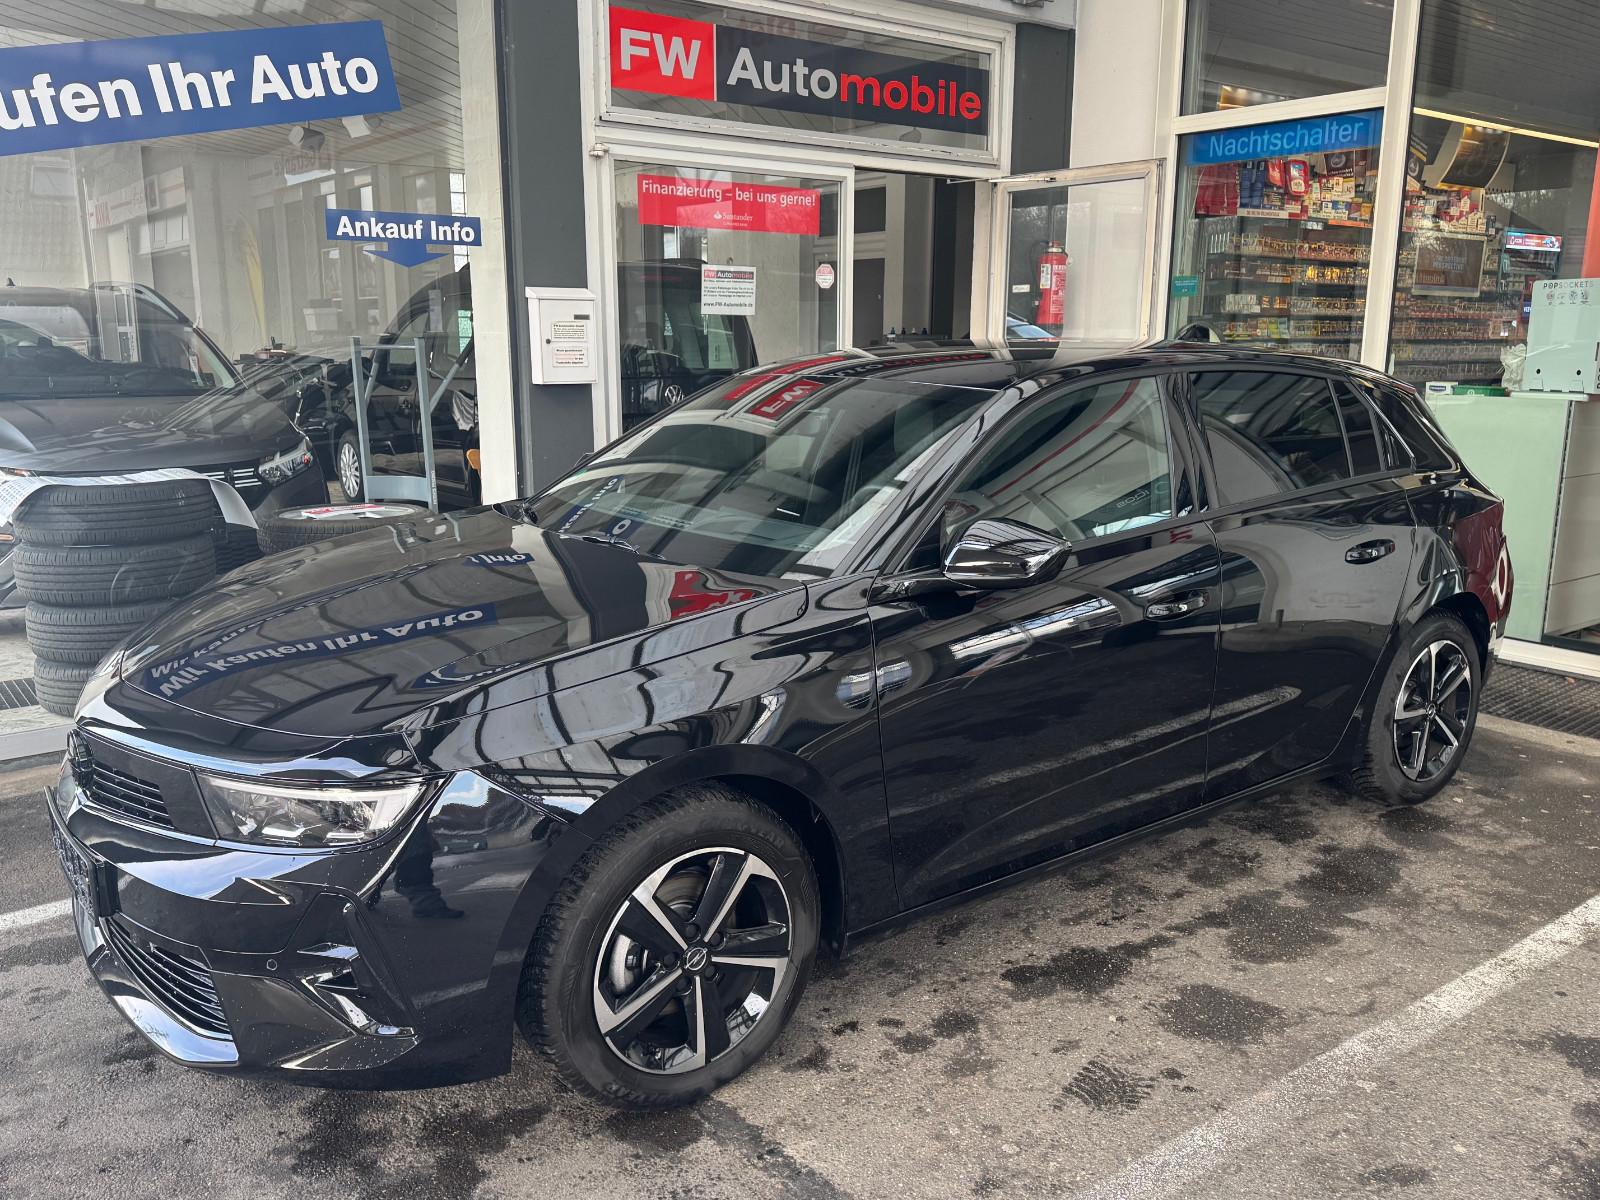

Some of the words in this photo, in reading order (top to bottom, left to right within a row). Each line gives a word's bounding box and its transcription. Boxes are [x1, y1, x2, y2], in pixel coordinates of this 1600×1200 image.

[619, 28, 702, 80] FW
[726, 47, 982, 121] Automobile
[0, 73, 142, 130] ufen
[147, 61, 236, 114] Ihr
[250, 50, 379, 104] Auto
[1209, 120, 1365, 158] Nachtschalter
[642, 180, 722, 201] Finanzierung
[735, 187, 753, 202] bei
[756, 194, 777, 204] uns
[779, 194, 817, 208] gerne!
[336, 215, 423, 240] Ankauf
[429, 219, 476, 243] Info
[723, 212, 754, 222] Santander
[1543, 281, 1594, 289] POPSOCKETS
